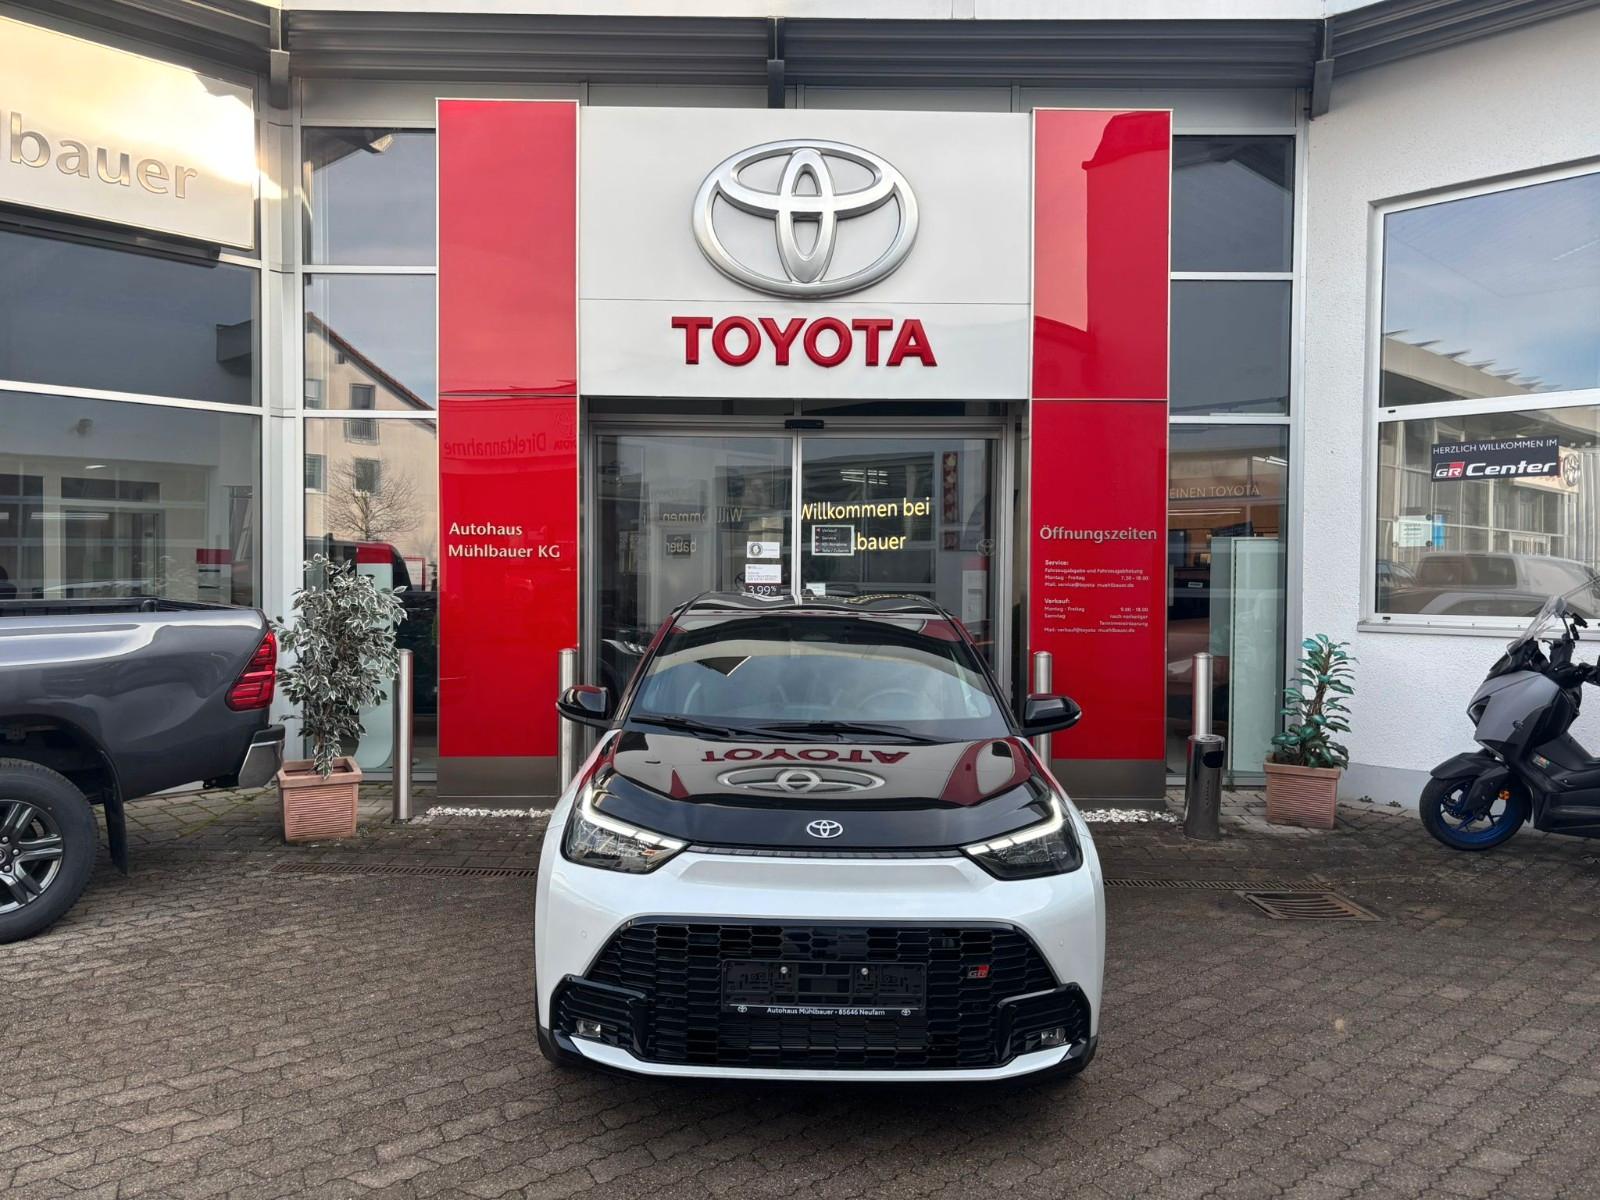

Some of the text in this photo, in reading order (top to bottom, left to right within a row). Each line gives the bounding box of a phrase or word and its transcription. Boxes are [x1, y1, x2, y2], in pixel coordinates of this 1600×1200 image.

[0, 109, 198, 199] bauer
[671, 316, 938, 368] TOYOTA
[1432, 438, 1558, 455] HERZLICH WILLKOMMEN IM
[1434, 460, 1557, 478] GR Center
[1210, 485, 1260, 497] TOYOTA
[903, 497, 930, 516] bei
[448, 522, 523, 536] Autohaus
[1040, 524, 1157, 543] Öffnungszeiten
[854, 532, 906, 550] bauer
[448, 544, 560, 558] Mühlbauer KG
